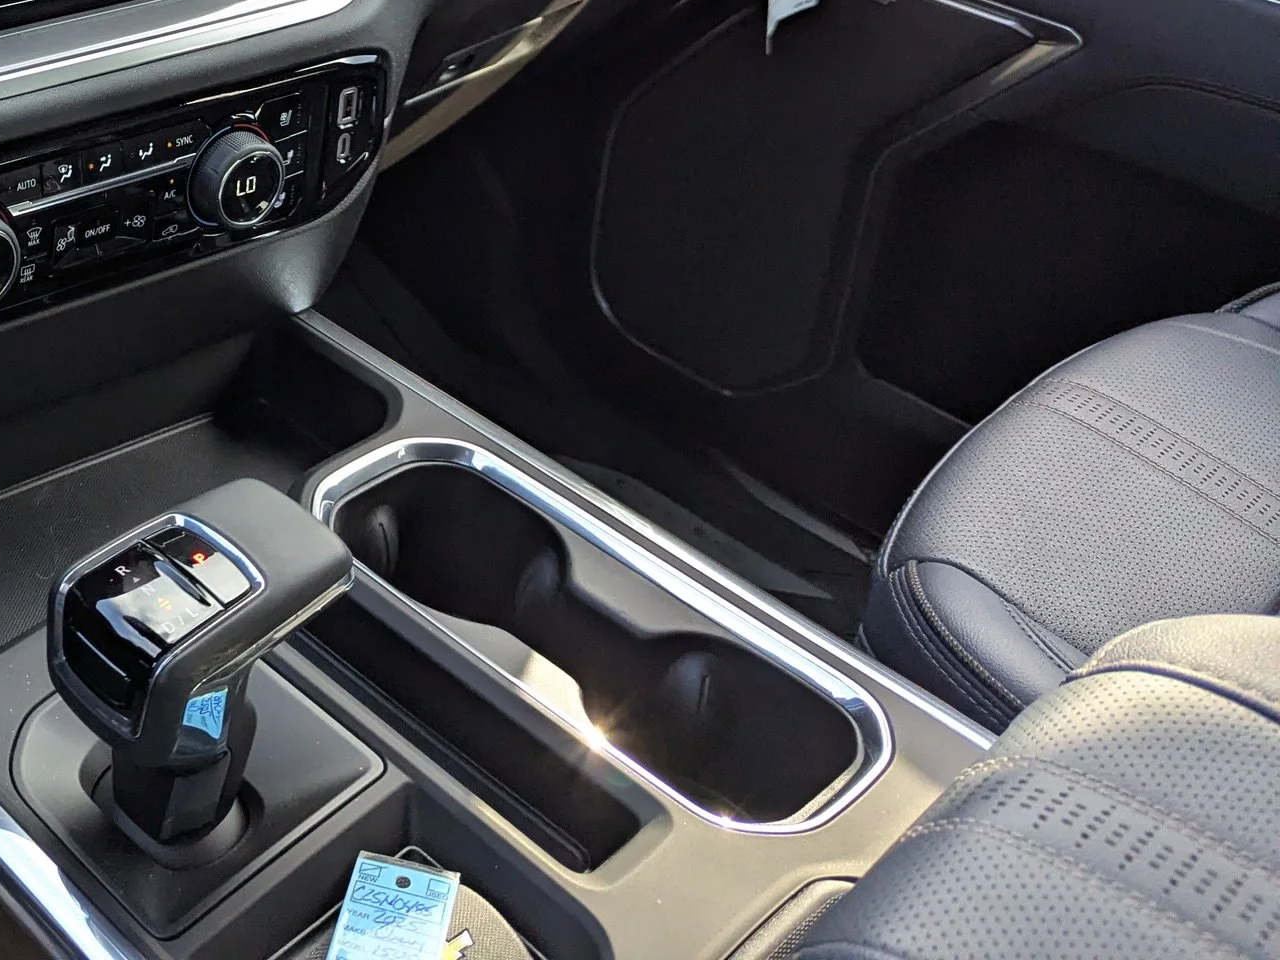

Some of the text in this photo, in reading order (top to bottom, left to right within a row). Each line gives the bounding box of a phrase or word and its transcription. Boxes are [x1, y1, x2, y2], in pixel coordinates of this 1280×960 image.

[175, 135, 193, 147] SYNC
[17, 178, 36, 191] AUTO
[164, 190, 176, 200] A/C
[84, 224, 111, 239] ON/OFF
[28, 239, 40, 247] MAX
[193, 553, 206, 565] P
[114, 565, 131, 576] R
[140, 584, 156, 596] N
[358, 874, 378, 884] NEW
[425, 889, 448, 901] USED
